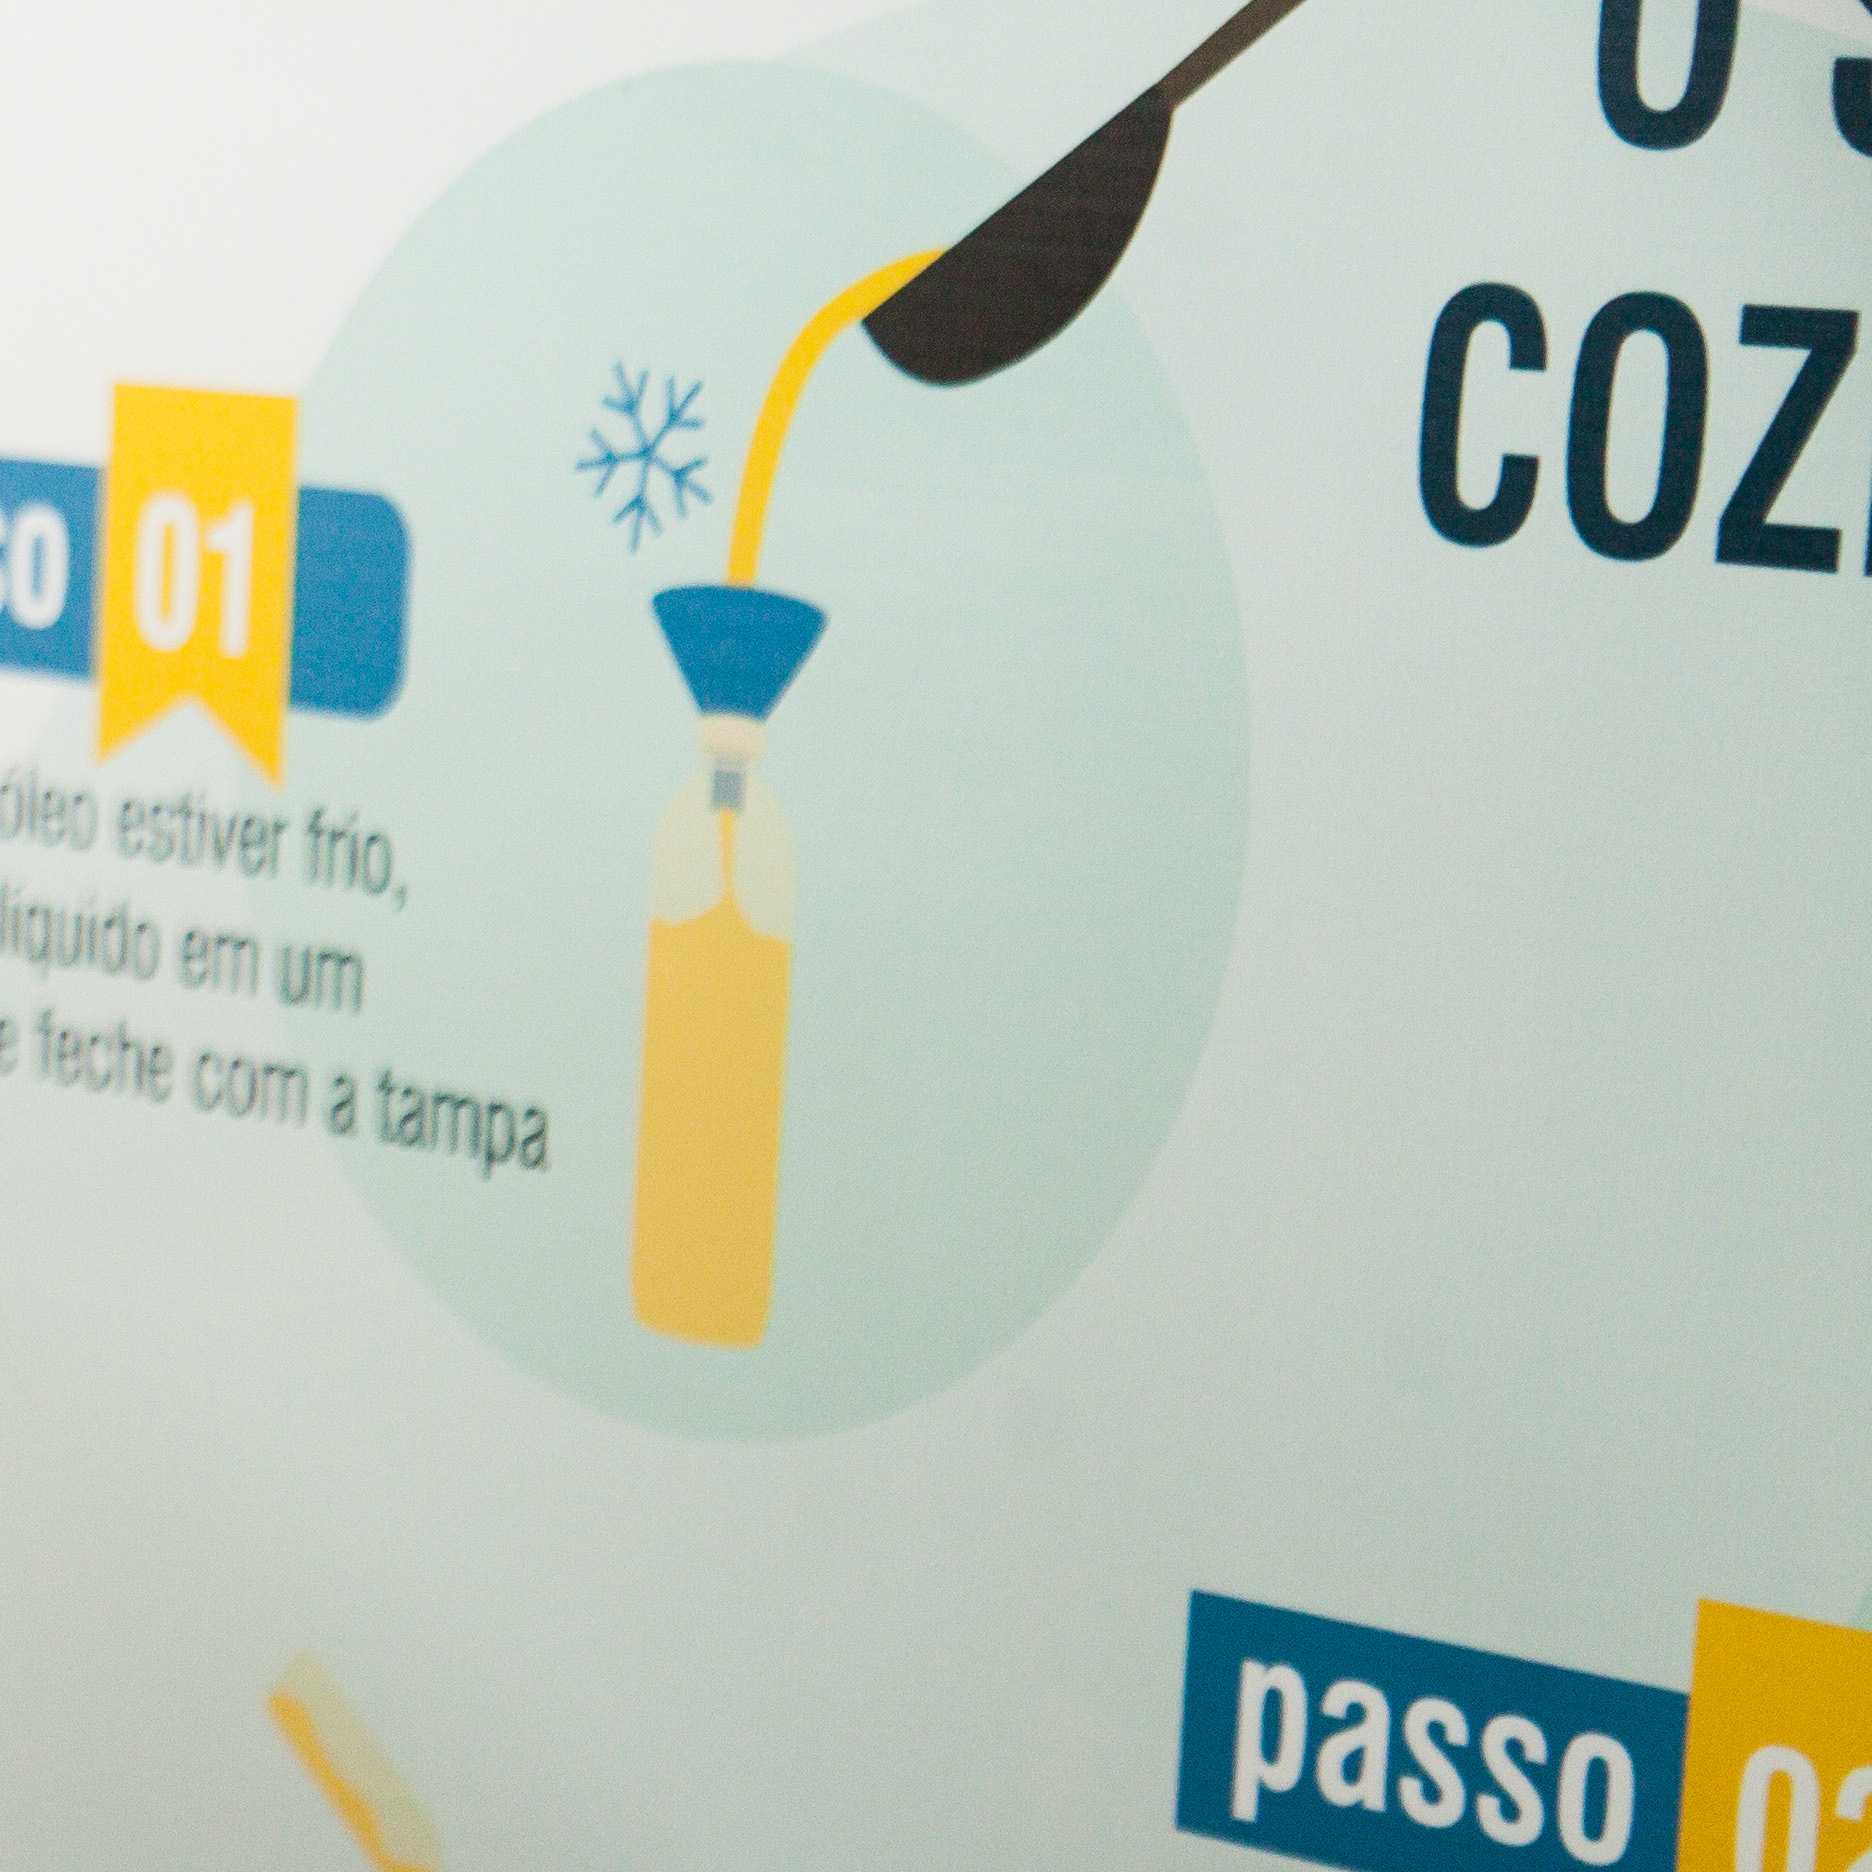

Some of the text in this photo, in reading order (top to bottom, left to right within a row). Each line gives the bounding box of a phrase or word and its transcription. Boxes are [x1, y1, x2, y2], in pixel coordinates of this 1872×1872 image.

[1419, 281, 1872, 578] COZ
[132, 489, 256, 660] 01
[116, 784, 286, 878] estiver
[305, 803, 410, 913] frio,
[181, 925, 258, 998] em
[282, 942, 365, 1015] um
[36, 1006, 174, 1103] feche
[189, 1046, 309, 1128] com
[326, 1072, 358, 1139] a
[377, 1069, 551, 1180] tampa
[1231, 1656, 1637, 1868] passo
